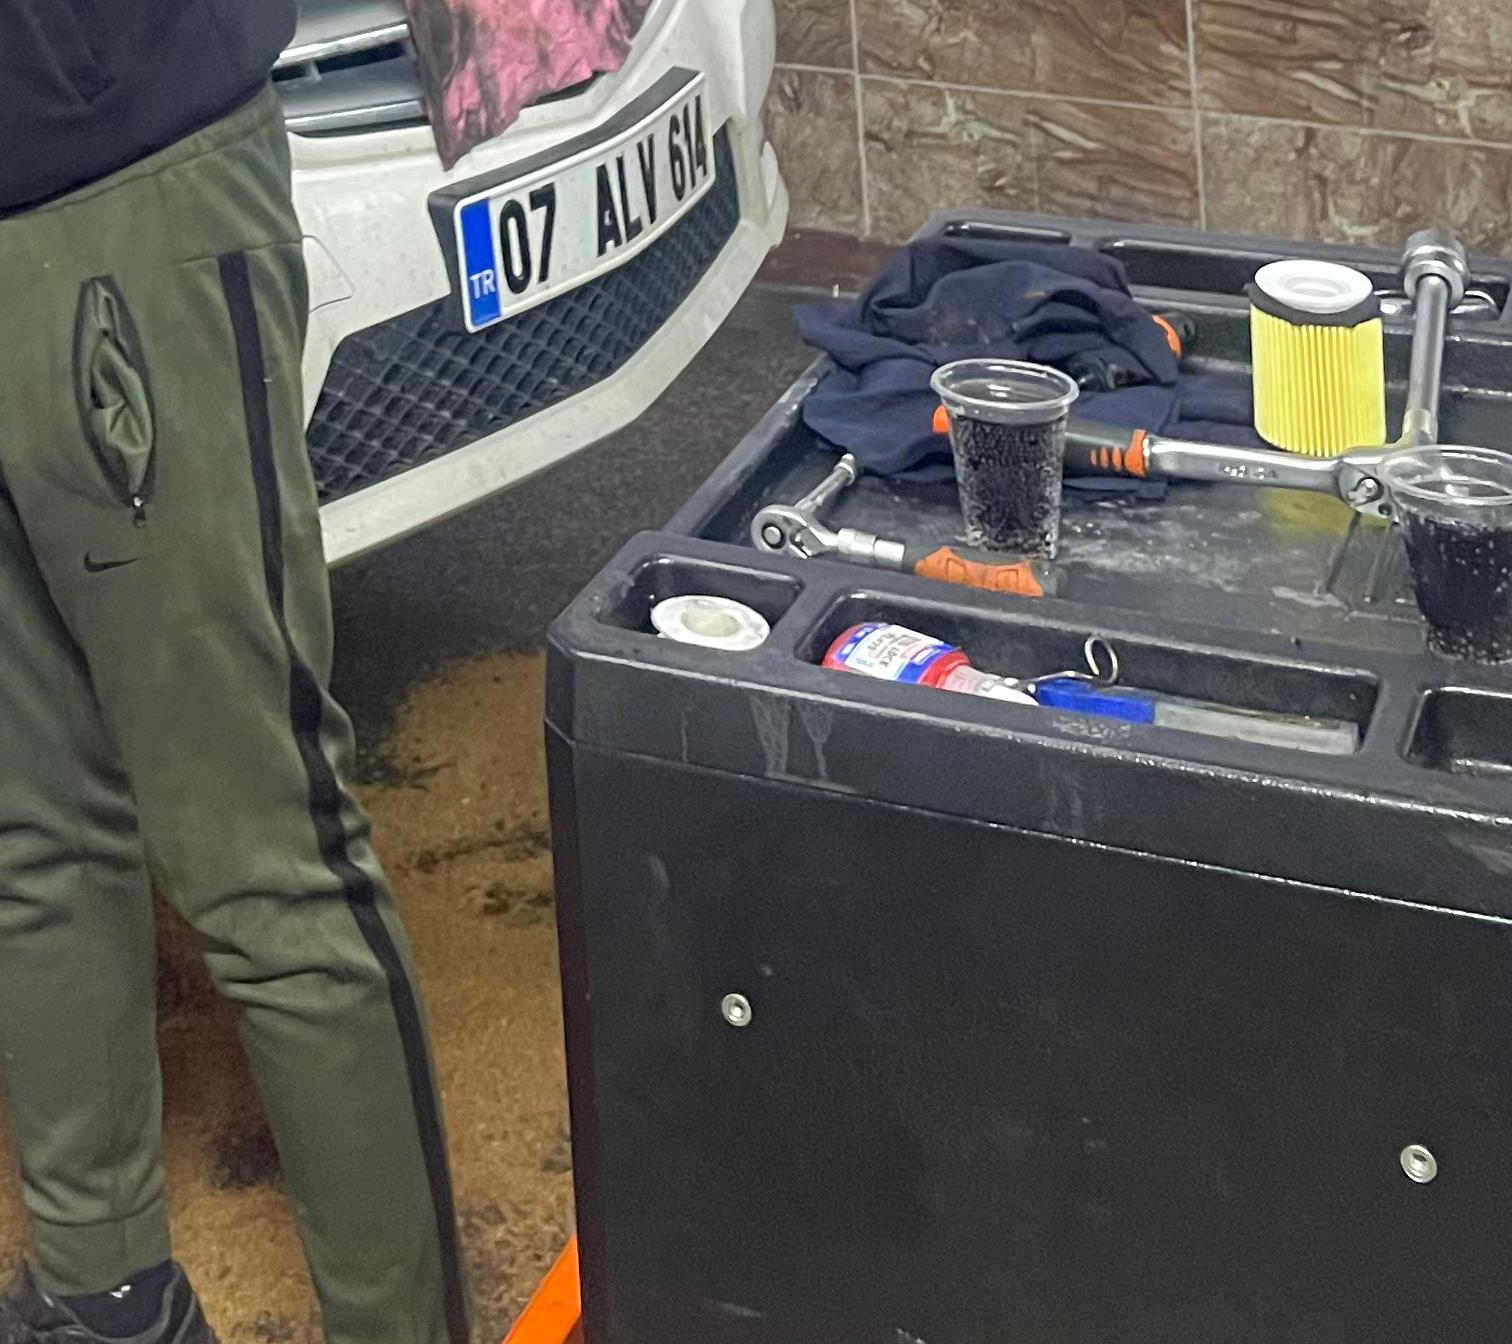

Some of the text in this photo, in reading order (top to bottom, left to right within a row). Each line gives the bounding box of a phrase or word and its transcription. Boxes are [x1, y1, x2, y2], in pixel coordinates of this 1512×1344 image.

[470, 95, 707, 300] TR 07 ALV 614
